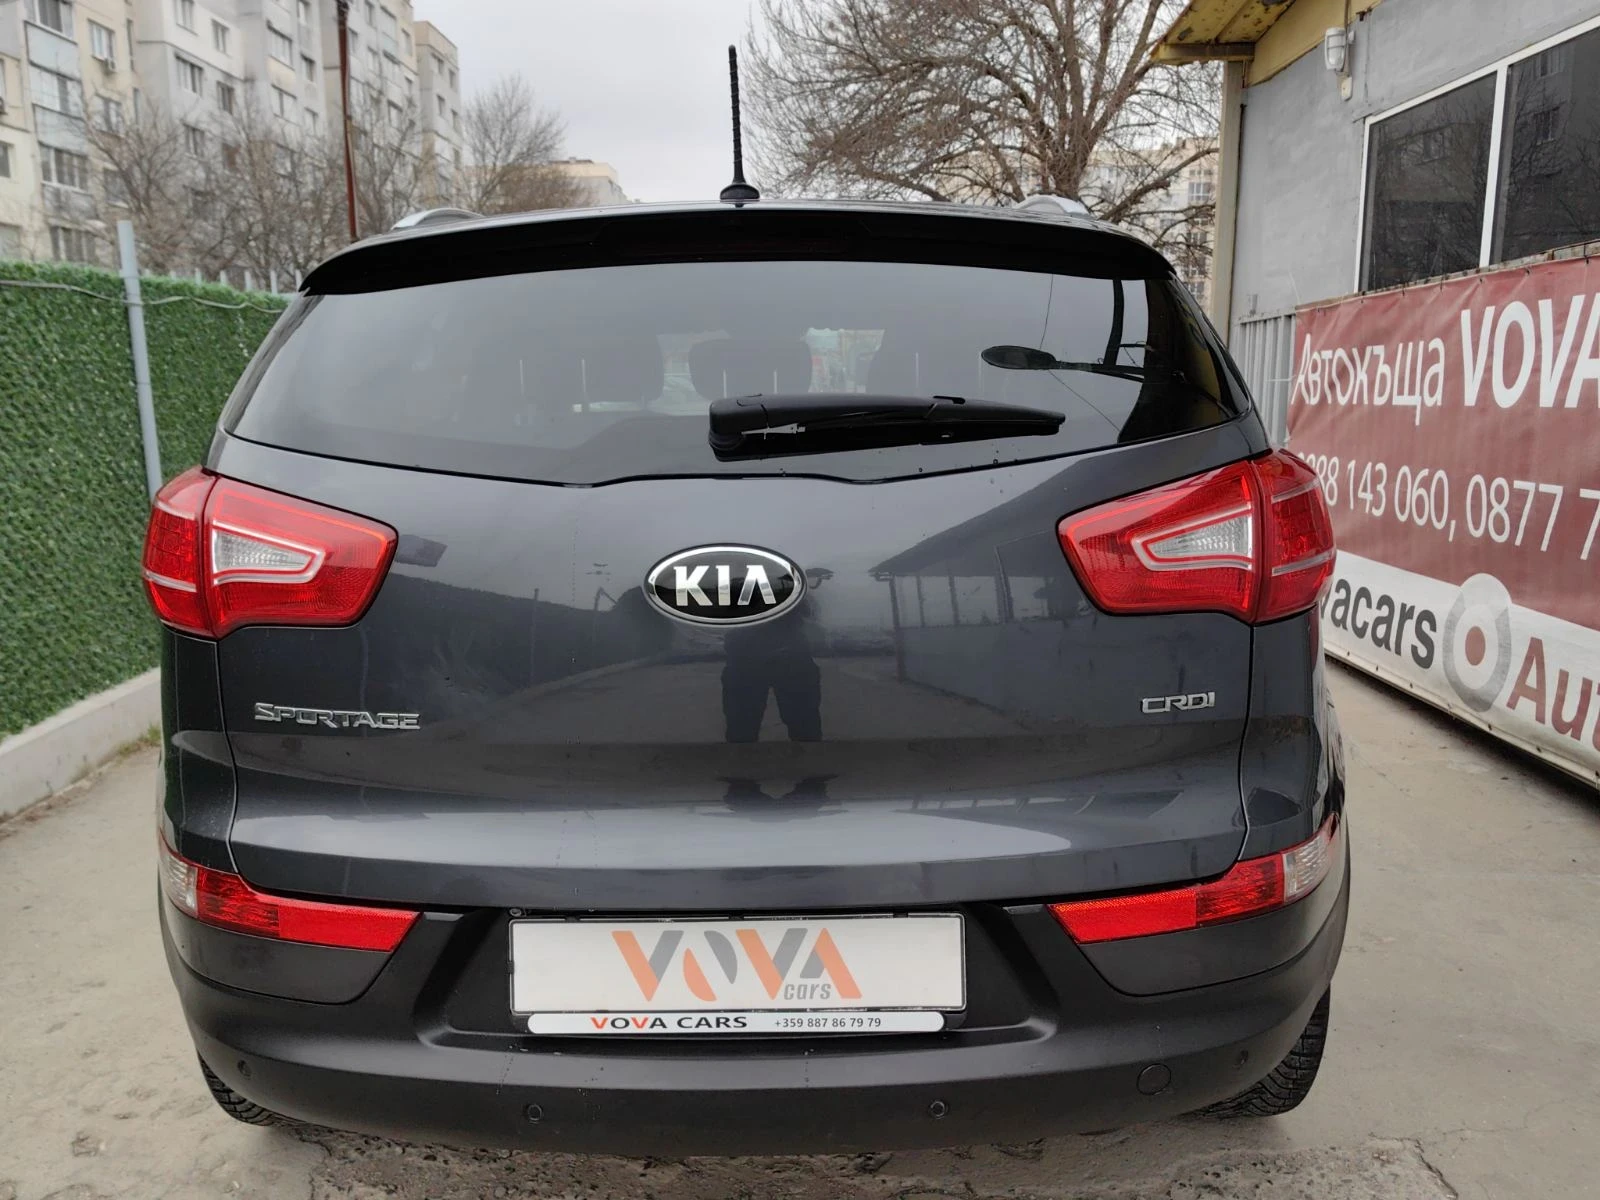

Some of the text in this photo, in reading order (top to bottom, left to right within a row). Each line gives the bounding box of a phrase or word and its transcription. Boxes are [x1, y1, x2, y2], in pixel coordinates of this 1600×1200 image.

[1291, 292, 1600, 426] Автокъща VOVA
[1347, 459, 1388, 517] 143
[1394, 465, 1456, 542] 060,
[1466, 474, 1564, 552] 0877
[673, 565, 777, 607] KIA
[254, 702, 421, 730] SPORTAGE
[1506, 636, 1600, 752] Au
[611, 927, 863, 1002] VOVA
[783, 982, 832, 1001] cars
[590, 1016, 882, 1030] VOVA CARS +359 887 86 79 79
